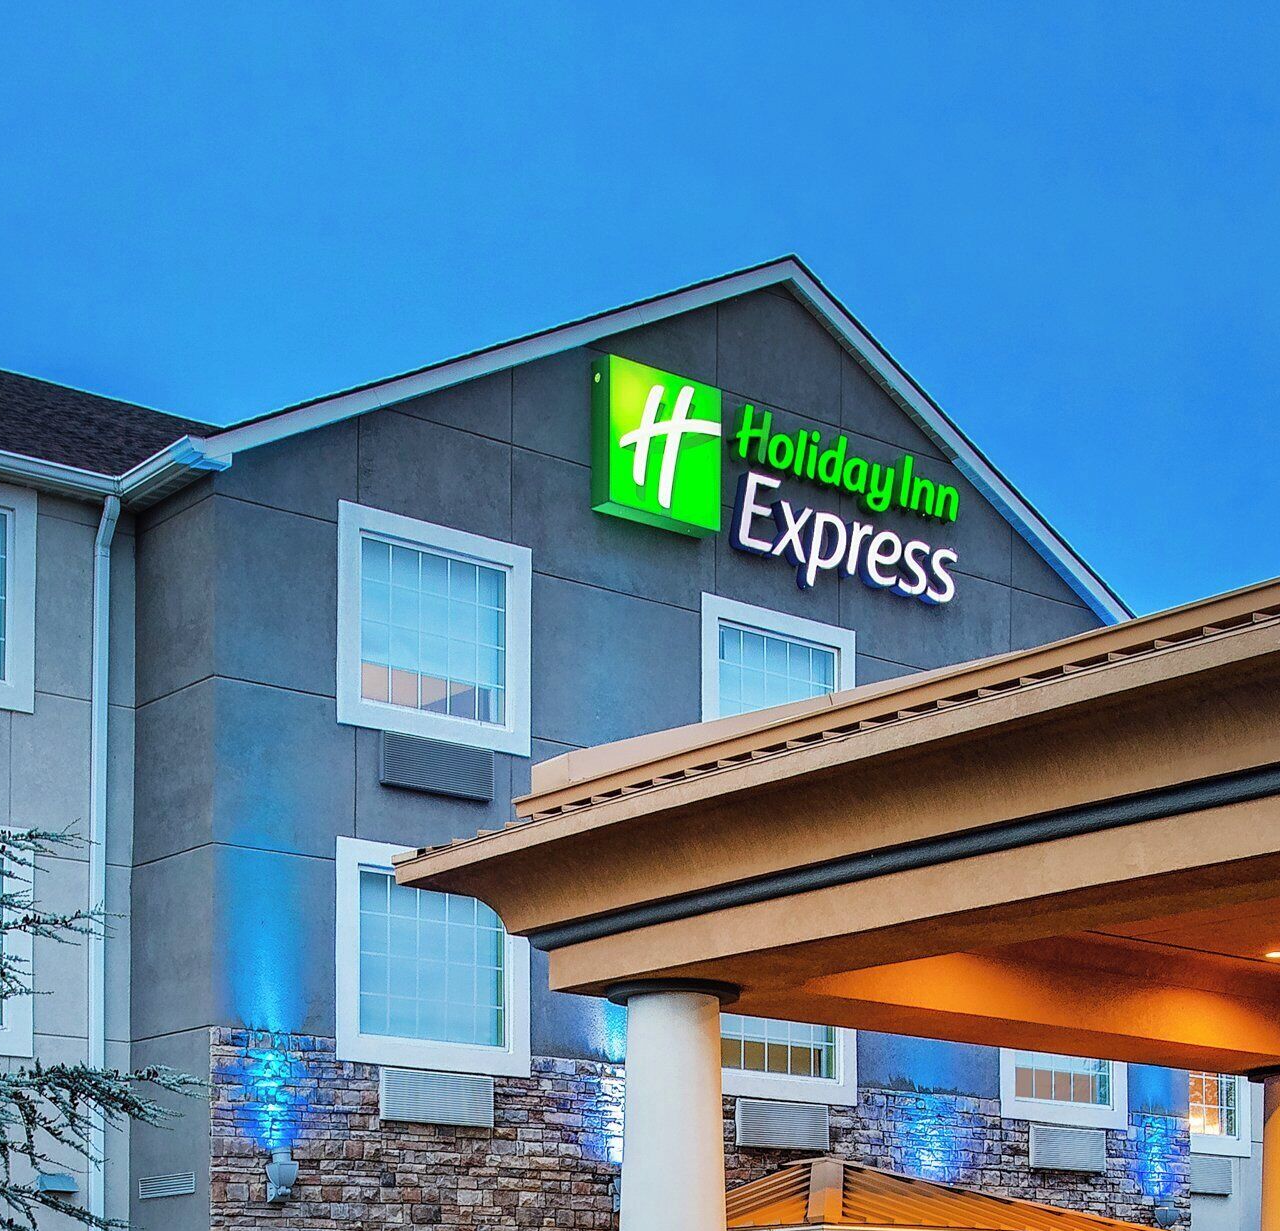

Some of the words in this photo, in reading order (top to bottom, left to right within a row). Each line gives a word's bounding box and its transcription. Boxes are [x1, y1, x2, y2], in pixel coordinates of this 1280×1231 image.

[732, 403, 895, 513] Holiday
[899, 453, 961, 523] Inn
[736, 471, 959, 604] Express
